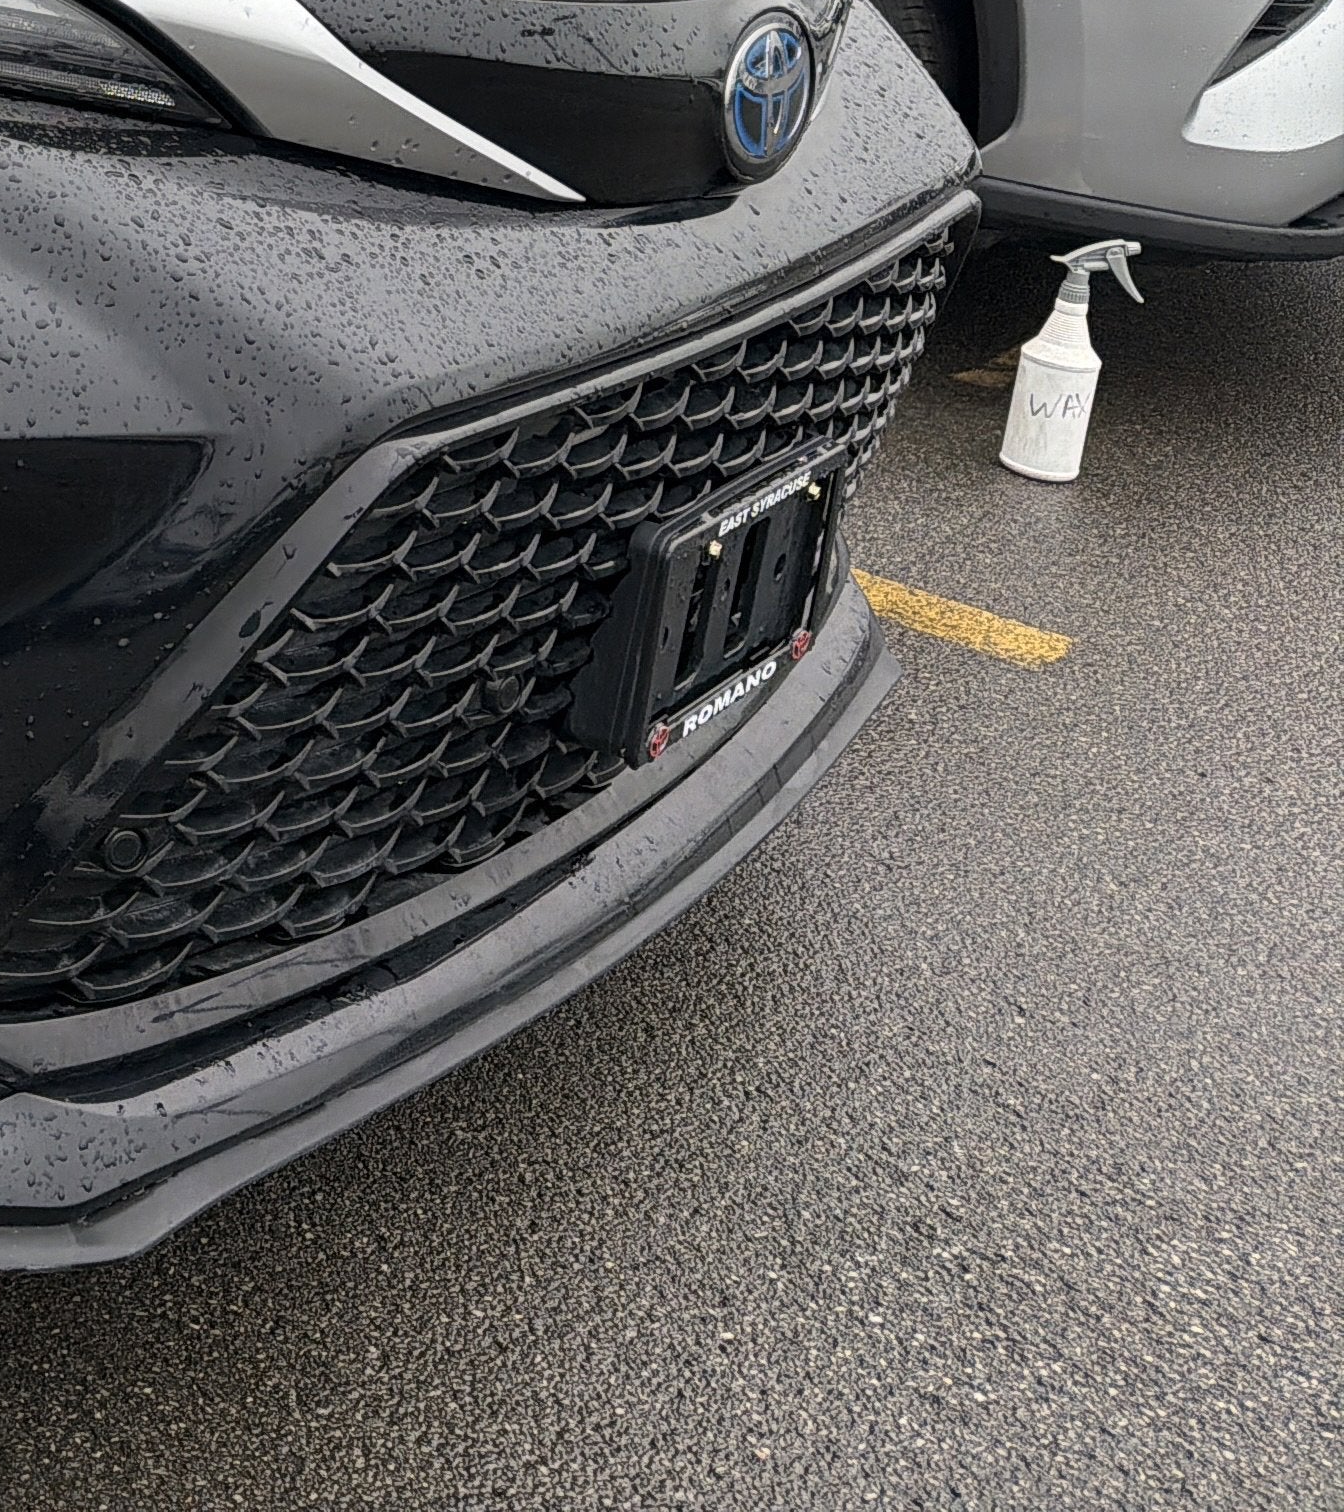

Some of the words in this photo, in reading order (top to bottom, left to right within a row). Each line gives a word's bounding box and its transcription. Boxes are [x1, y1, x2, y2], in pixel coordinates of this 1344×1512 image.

[1029, 392, 1091, 419] WAX
[718, 507, 750, 537] EAST
[750, 471, 811, 518] SYRACUSE
[682, 661, 777, 738] ROMANO
